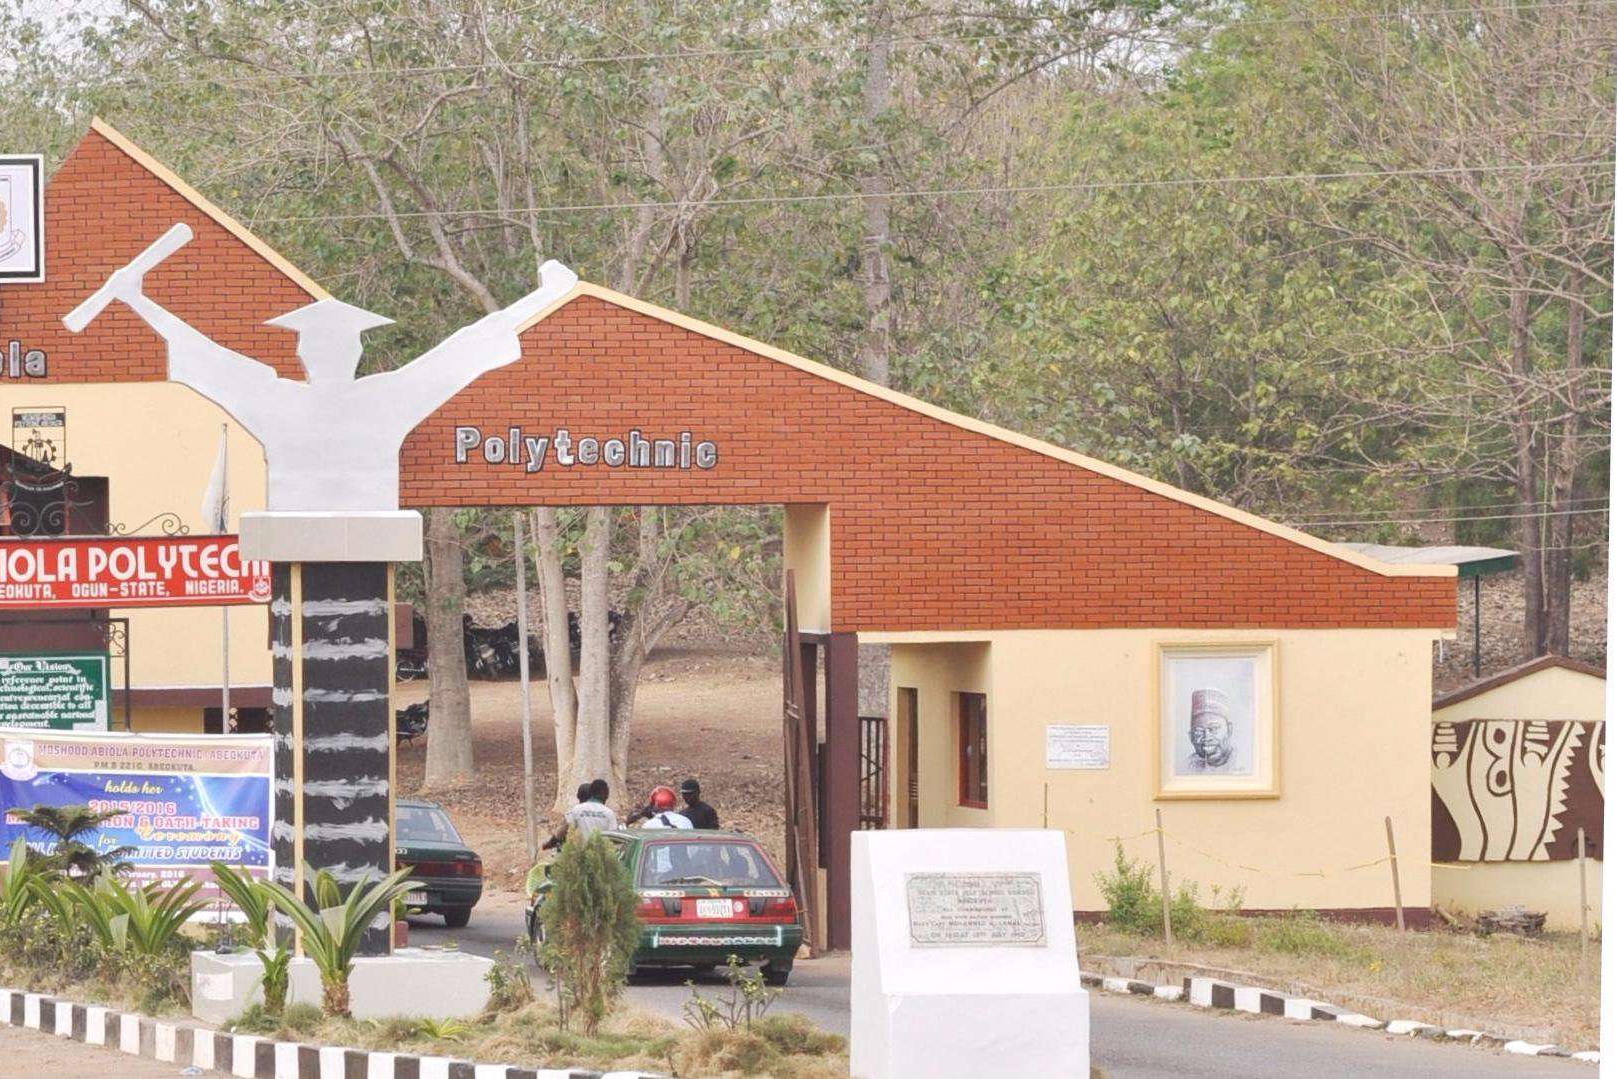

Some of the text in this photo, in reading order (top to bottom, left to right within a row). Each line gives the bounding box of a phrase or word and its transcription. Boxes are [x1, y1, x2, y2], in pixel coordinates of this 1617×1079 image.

[454, 426, 718, 473] Polytechnic
[72, 581, 170, 598] OGUN-STATE,
[185, 579, 245, 596] NIGERIA.
[1, 675, 44, 685] reference
[47, 676, 73, 686] point
[76, 675, 87, 684] in
[67, 701, 76, 710] to
[39, 745, 88, 757] MOSHOOD
[92, 747, 128, 758] ABIOLA
[105, 780, 164, 794] holds her
[97, 832, 118, 848] for
[175, 846, 243, 860] STUDENTS
